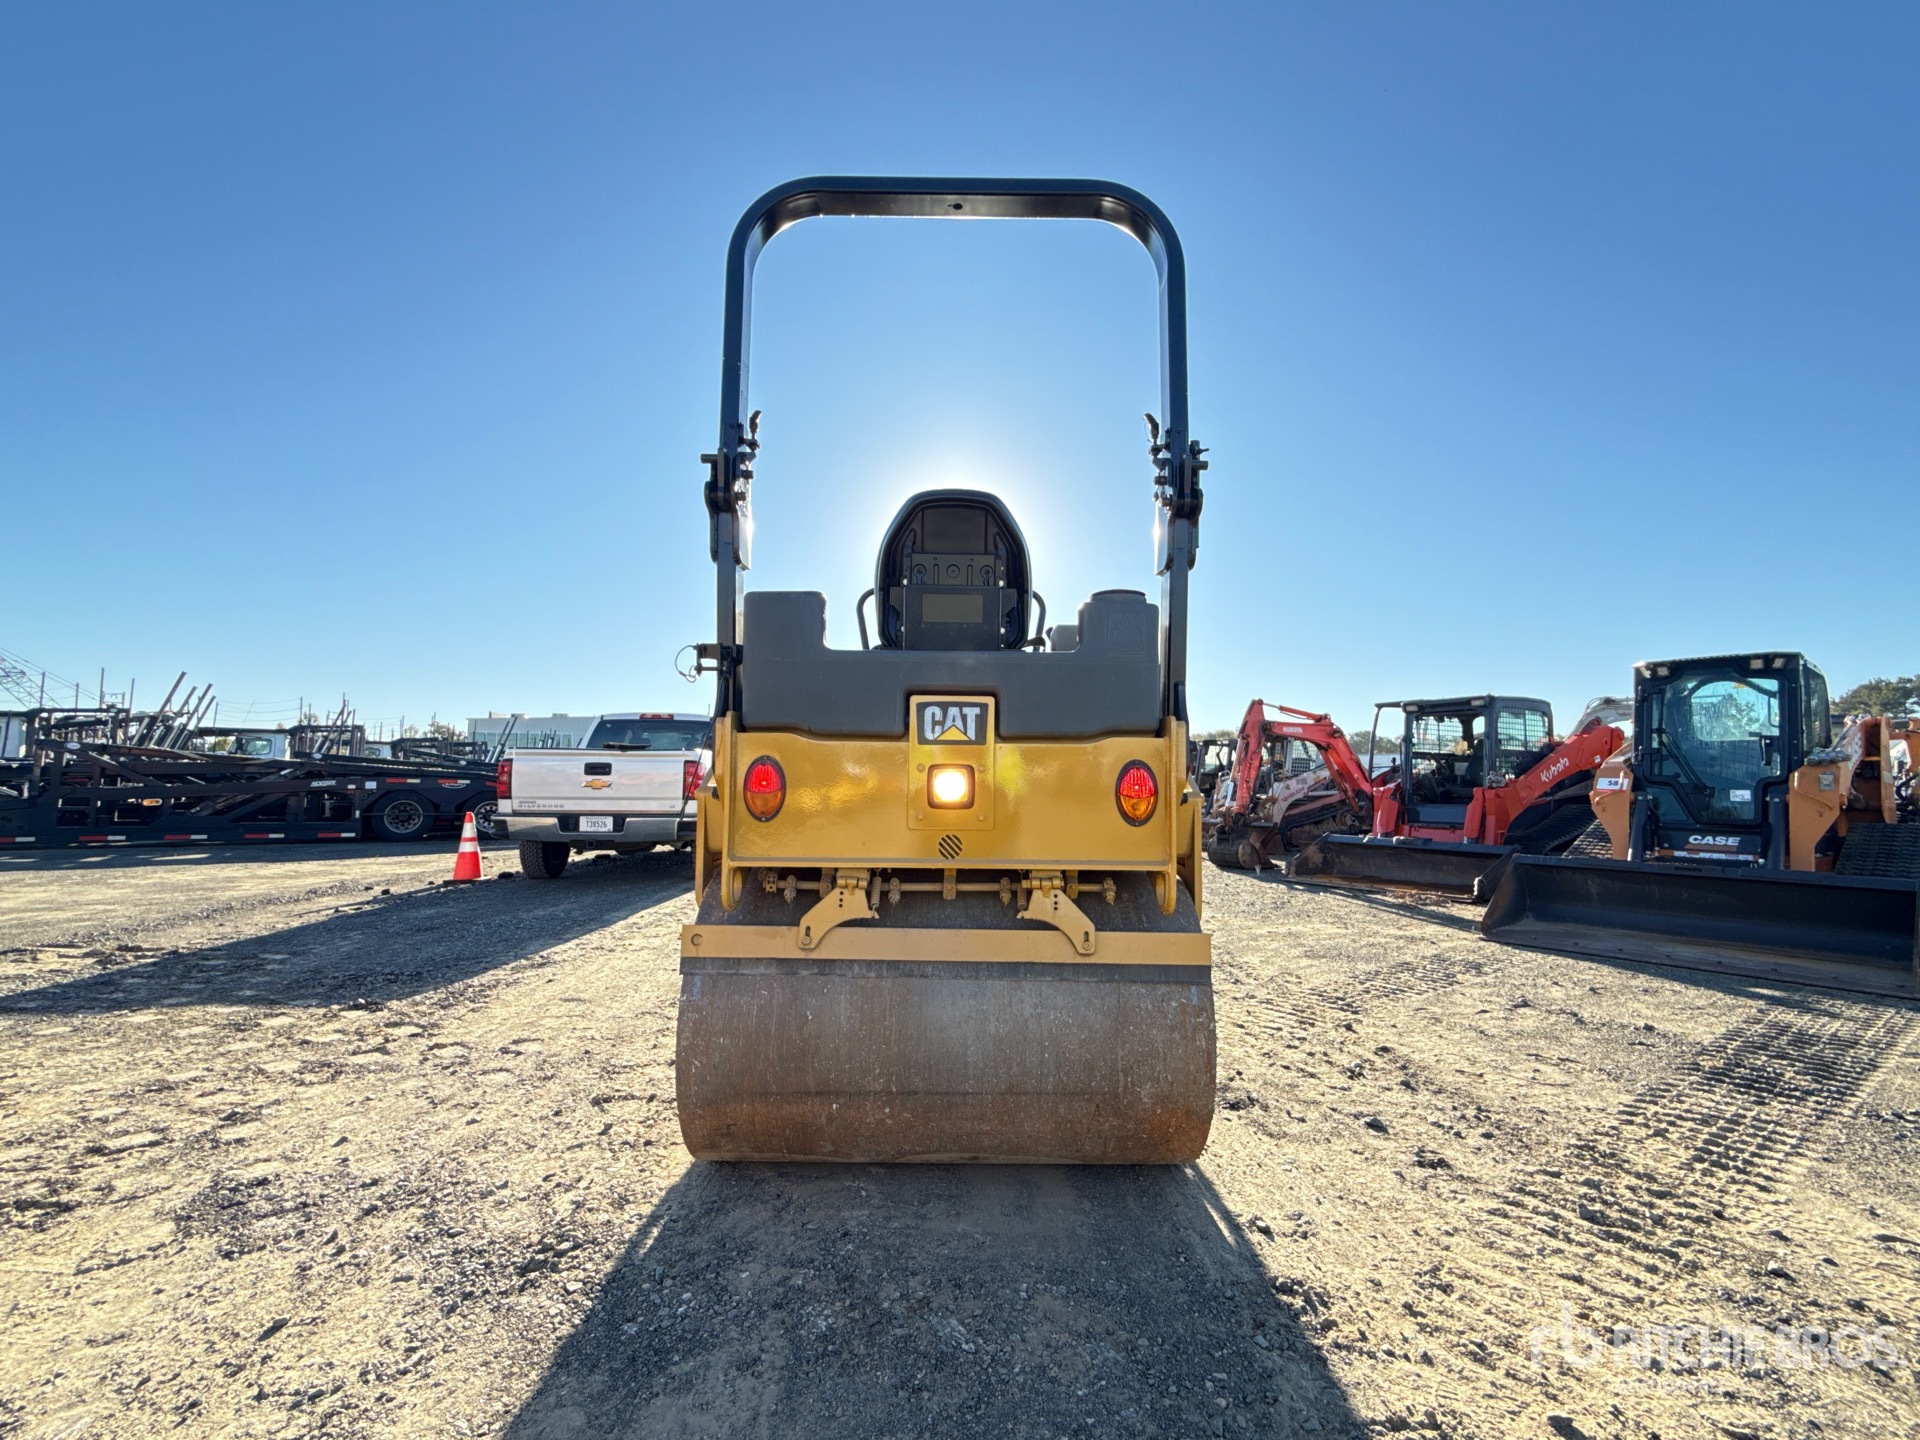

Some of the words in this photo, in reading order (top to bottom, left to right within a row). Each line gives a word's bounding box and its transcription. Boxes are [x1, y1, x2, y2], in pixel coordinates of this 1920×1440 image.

[924, 705, 981, 741] CAT
[1540, 757, 1570, 782] Kubota
[1688, 834, 1741, 846] CASE
